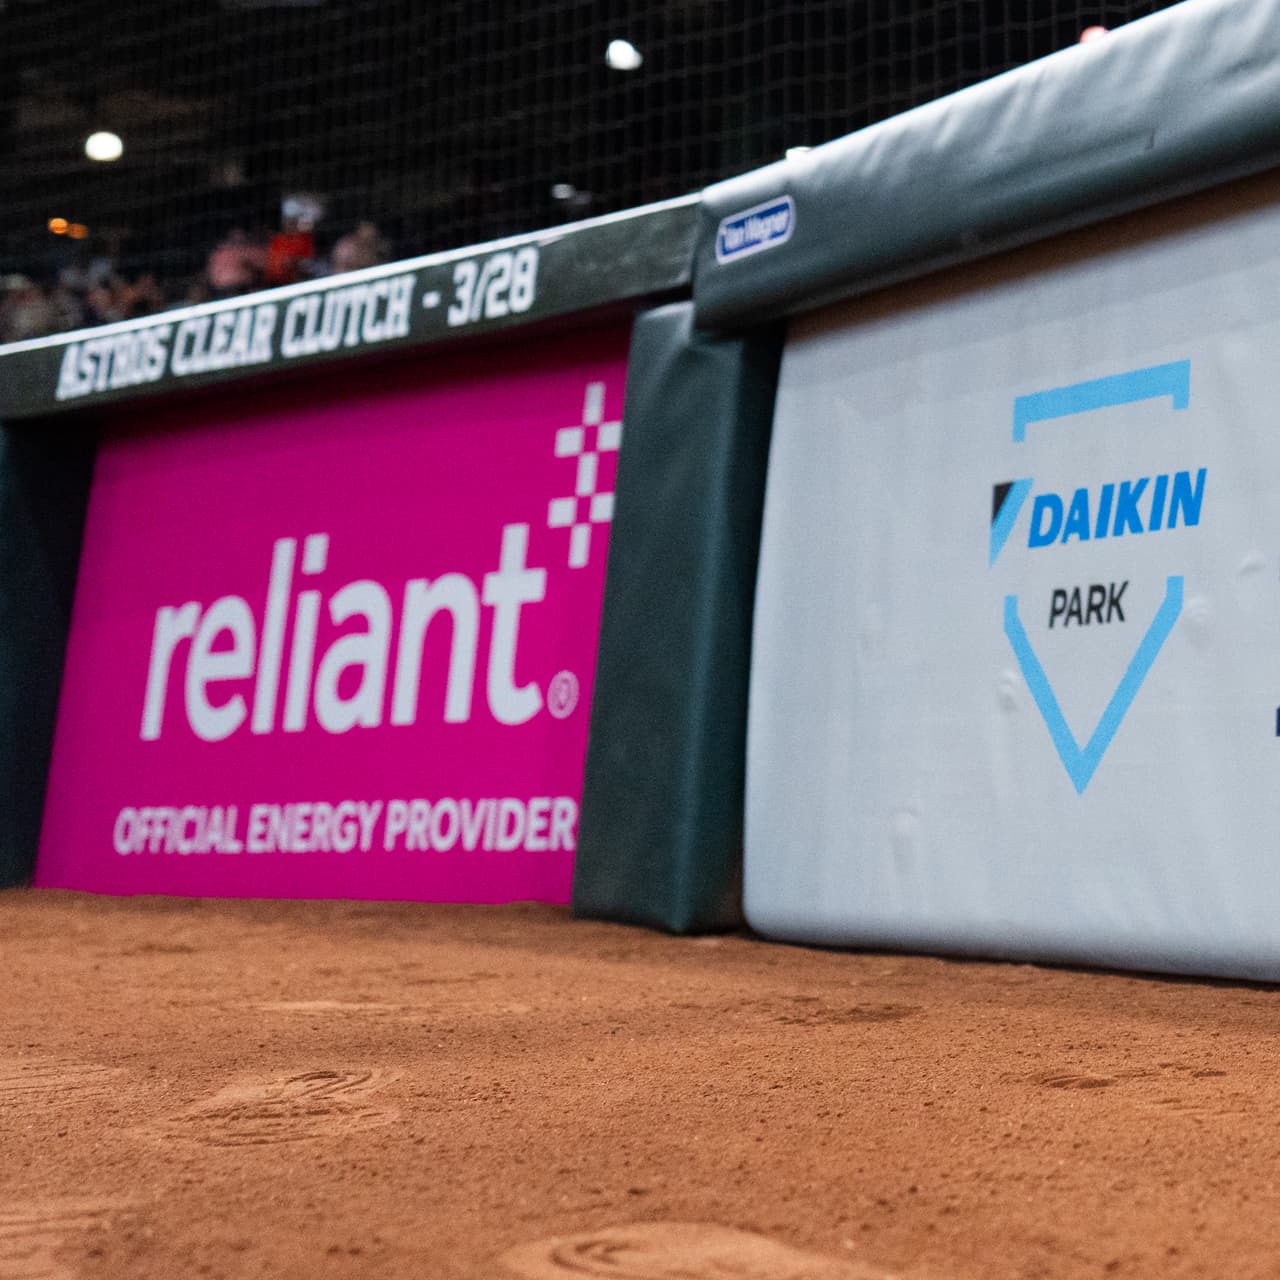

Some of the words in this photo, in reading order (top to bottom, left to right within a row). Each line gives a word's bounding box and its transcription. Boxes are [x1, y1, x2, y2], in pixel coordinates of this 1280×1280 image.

[55, 324, 168, 402] ASTROS
[171, 301, 278, 377] CLEAR
[281, 273, 417, 358] CLUTCH
[447, 247, 540, 327] 3/28
[1027, 468, 1207, 548] DAIKIN
[141, 524, 545, 742] reliant
[1048, 581, 1129, 628] PARK
[113, 806, 243, 855] OFFICIAL
[246, 801, 383, 854] ENERGY
[383, 796, 579, 852] PROVIDER
